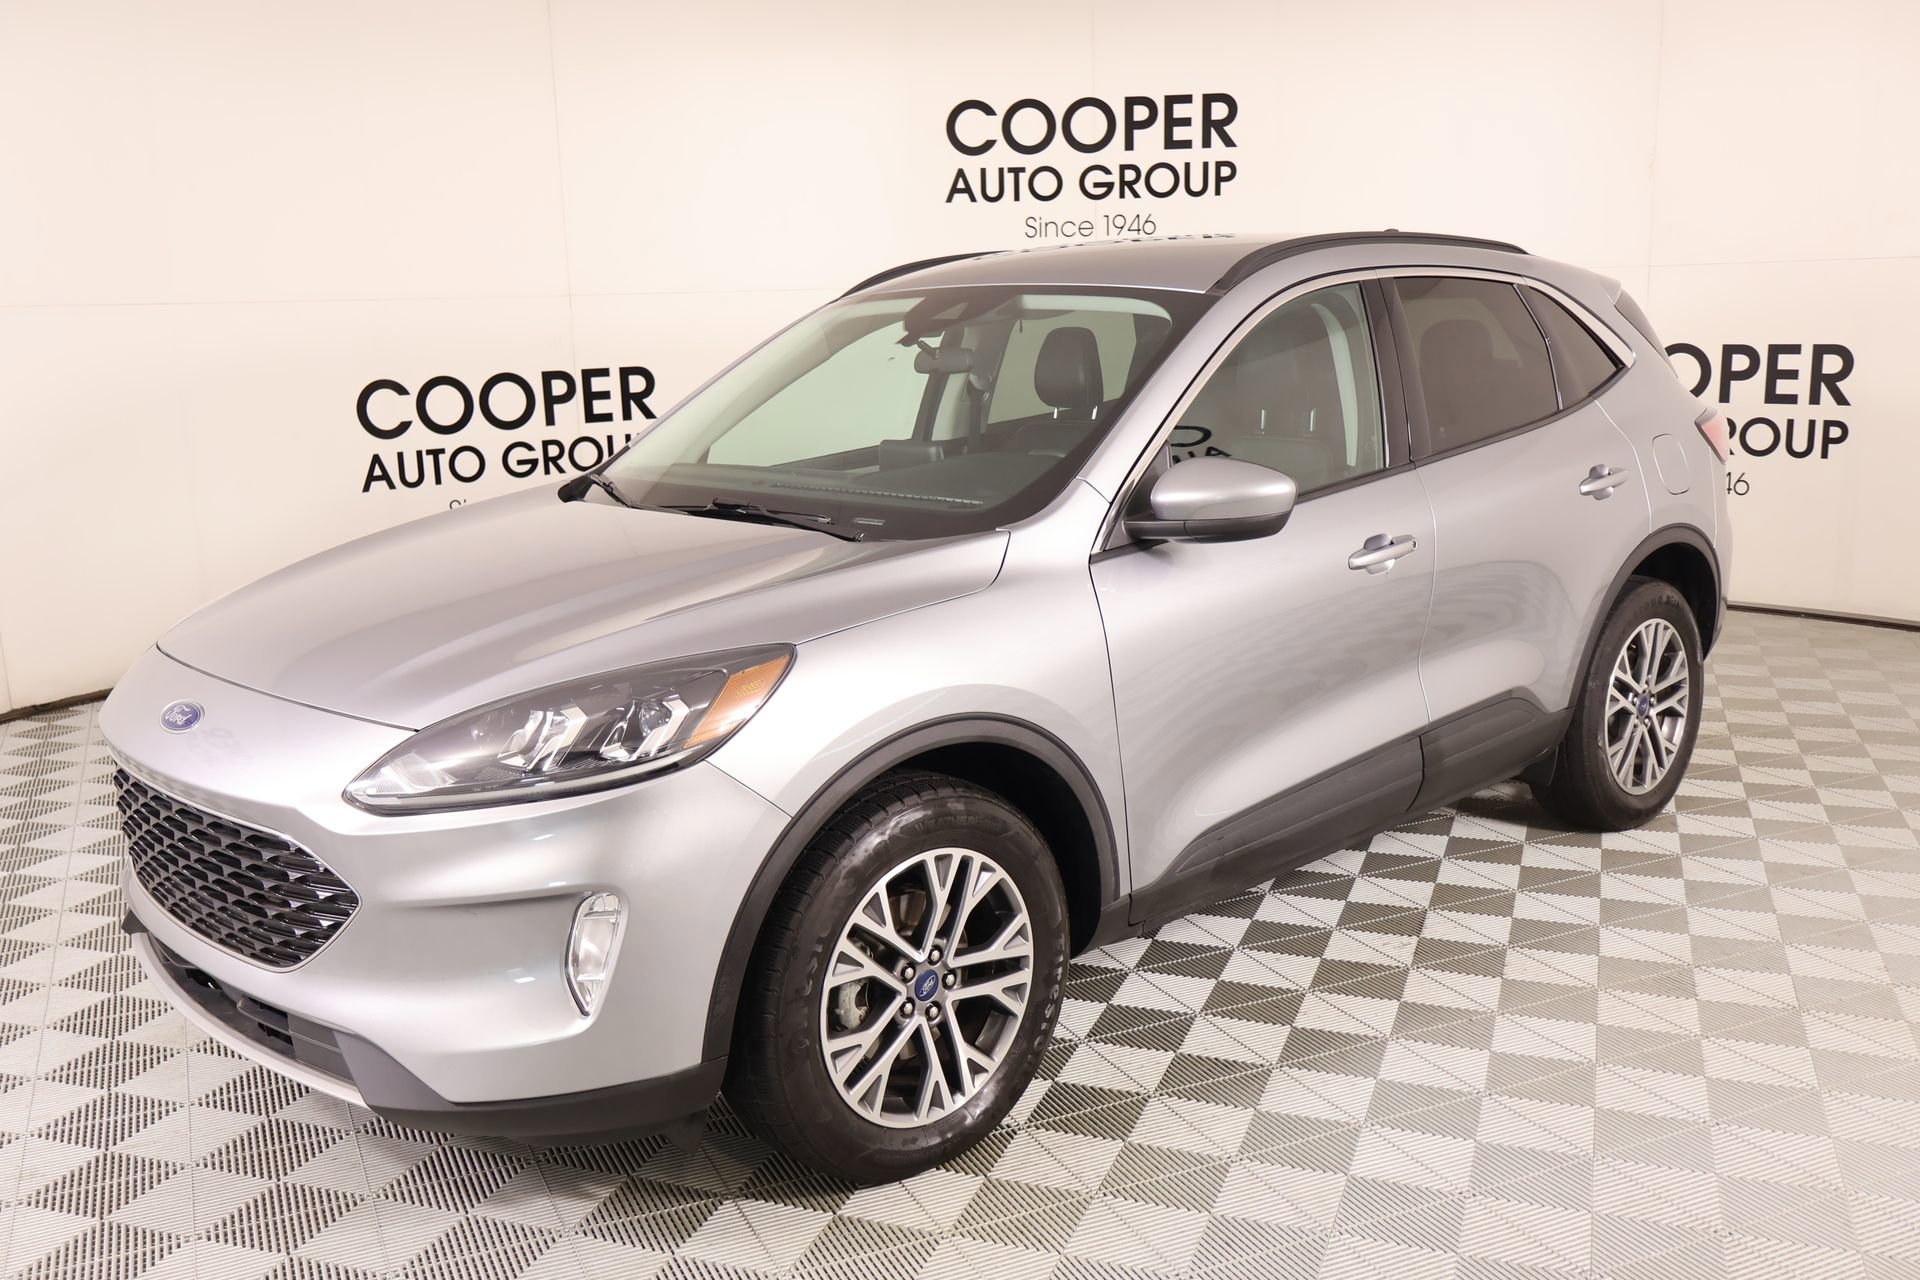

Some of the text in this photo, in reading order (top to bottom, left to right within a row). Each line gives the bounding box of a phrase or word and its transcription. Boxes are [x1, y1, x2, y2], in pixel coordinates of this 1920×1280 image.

[946, 93, 1238, 156] COOPER
[946, 161, 1236, 203] AUTO GROUP
[1025, 214, 1156, 238] Since 1946
[356, 366, 657, 440] COOPER
[1663, 343, 1855, 407] OPER
[362, 432, 639, 493] AUTO GRO
[1726, 417, 1848, 459] OUP
